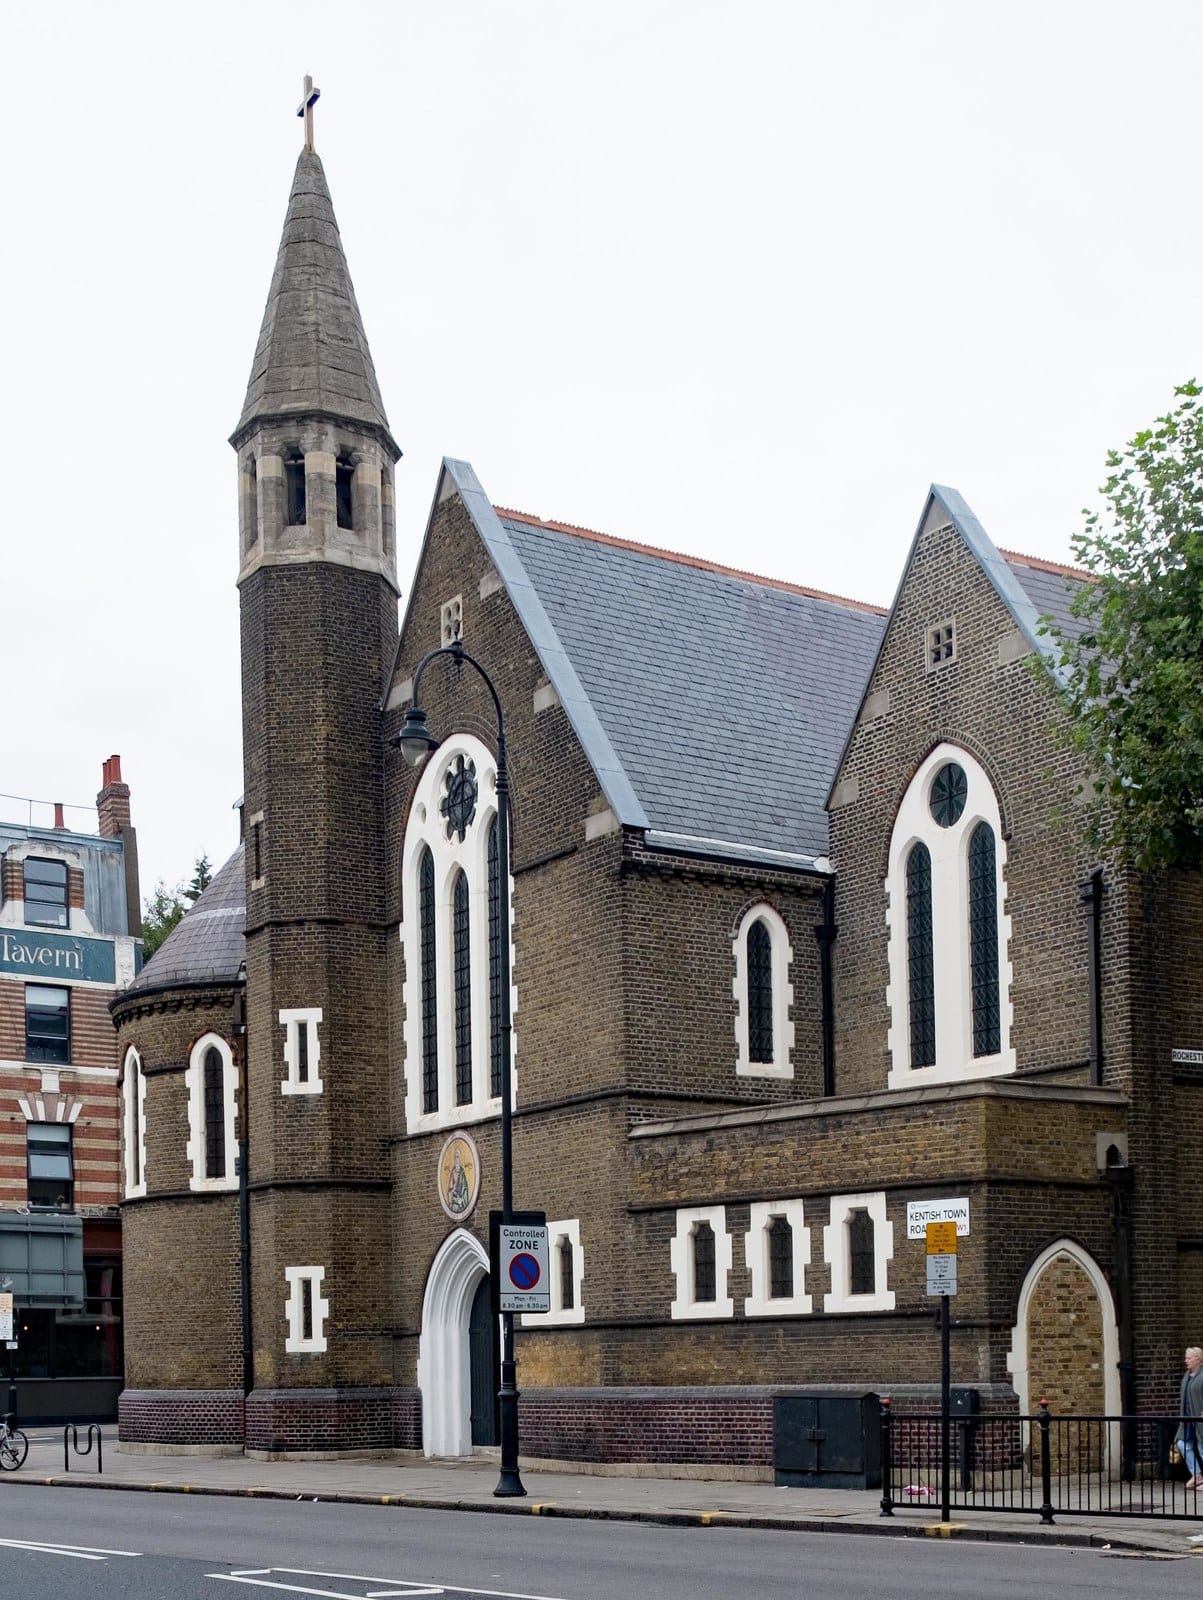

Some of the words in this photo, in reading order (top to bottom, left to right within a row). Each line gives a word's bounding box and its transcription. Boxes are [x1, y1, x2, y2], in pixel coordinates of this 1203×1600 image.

[0, 934, 79, 969] Tavern
[910, 1210, 941, 1221] KENTISH
[943, 1208, 967, 1219] TOWN
[503, 1229, 545, 1238] Controlled
[910, 1224, 927, 1234] ROA
[956, 1223, 967, 1232] W1
[509, 1240, 539, 1250] ZONE
